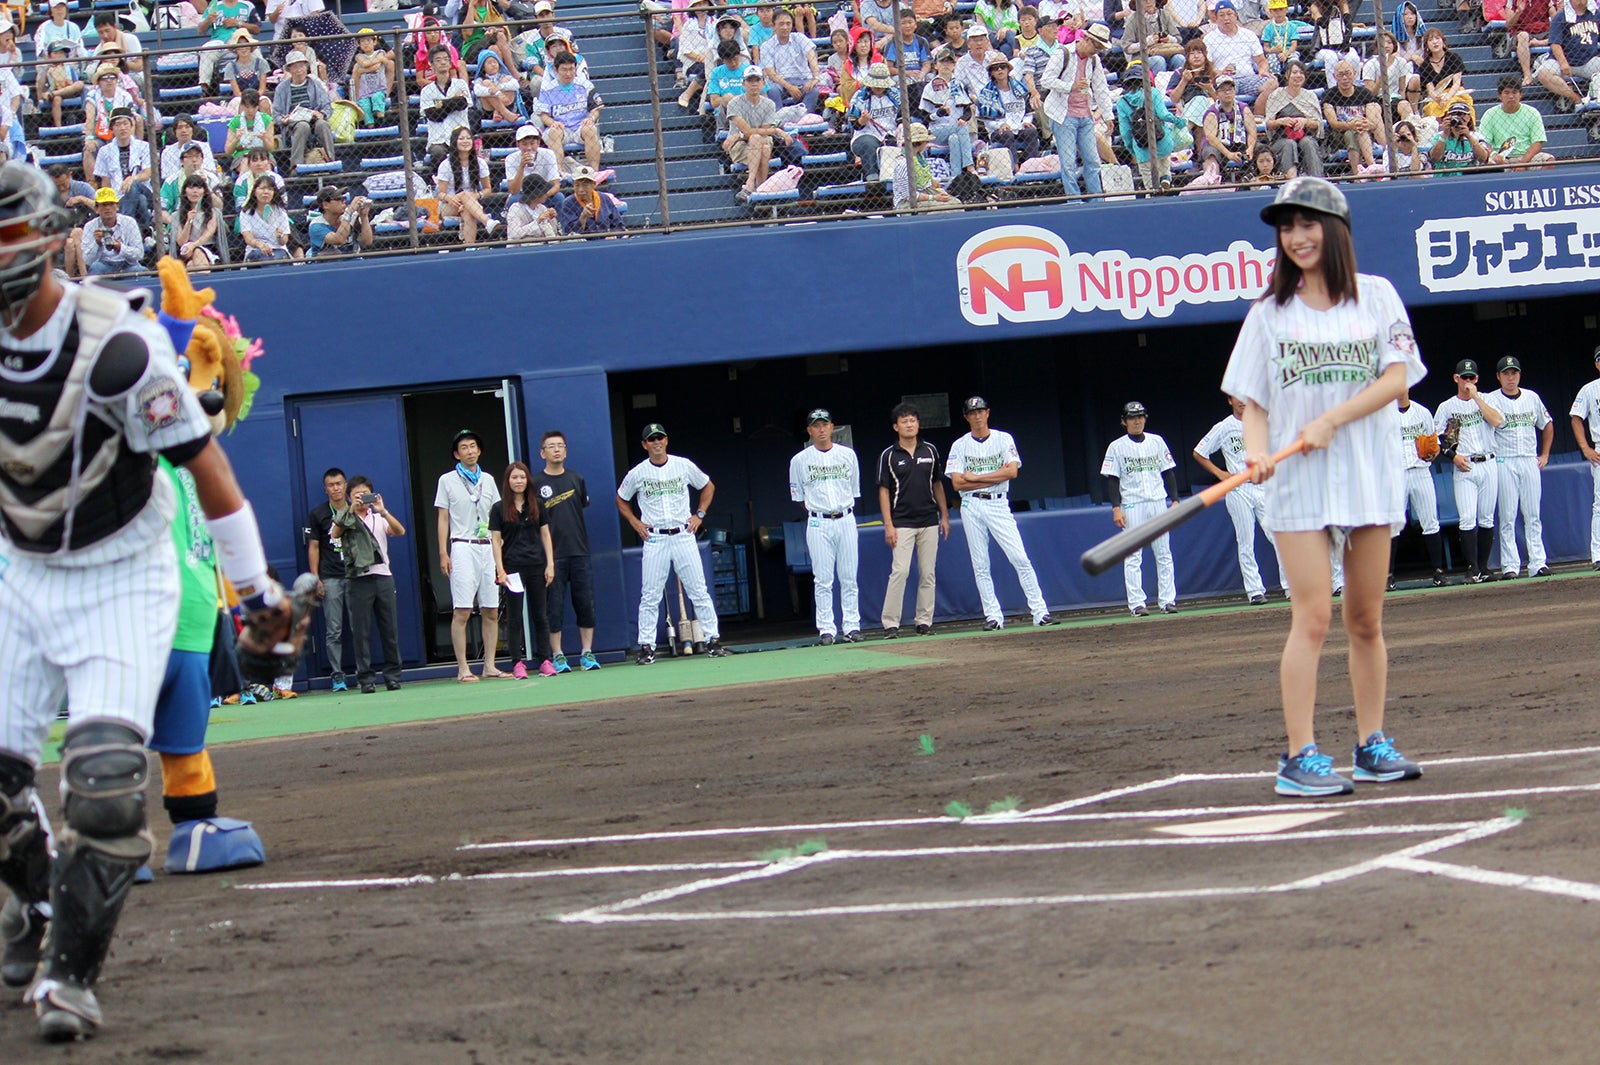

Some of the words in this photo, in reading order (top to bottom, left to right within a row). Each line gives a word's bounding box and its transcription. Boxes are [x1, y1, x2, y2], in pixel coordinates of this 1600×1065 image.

[1580, 32, 1593, 45] 24
[1485, 188, 1557, 212] SCHAU
[1563, 184, 1600, 206] ESS
[968, 260, 1064, 315] NH
[1304, 370, 1367, 386] FIGHTERS
